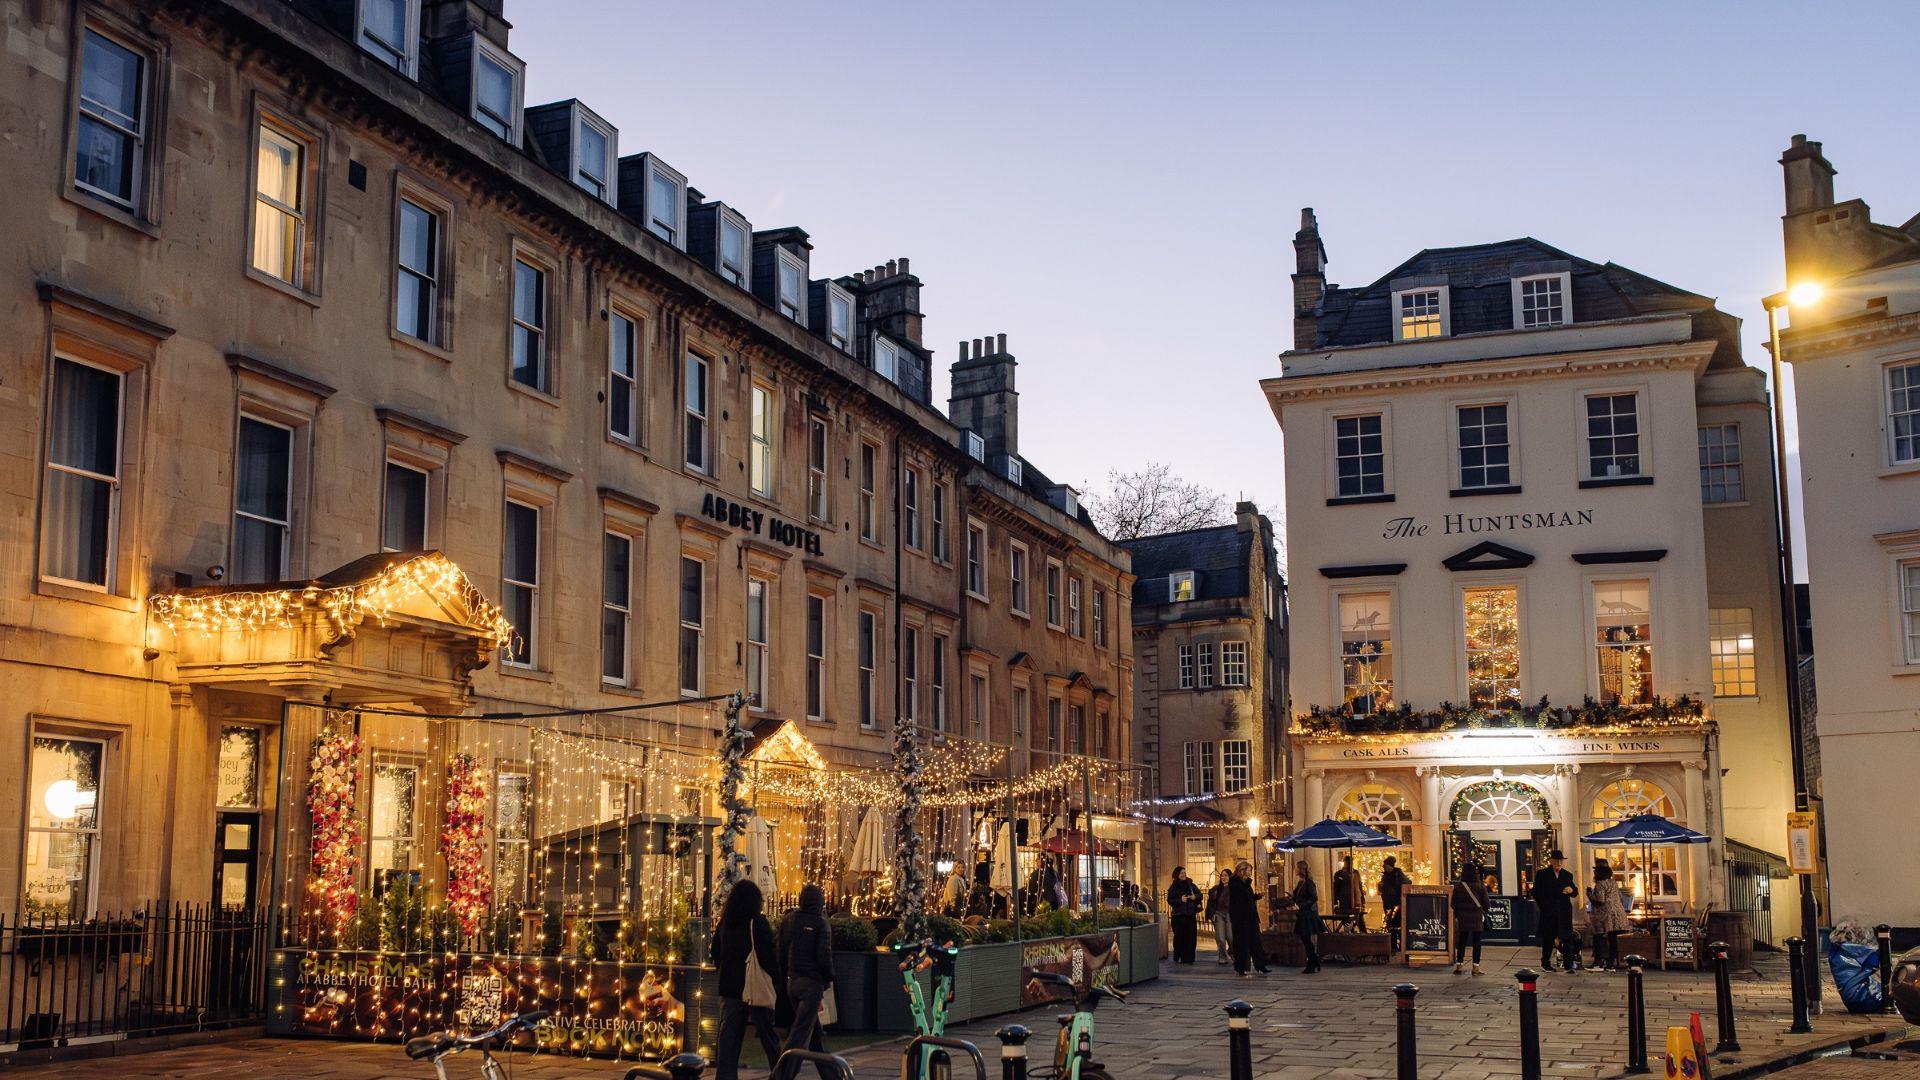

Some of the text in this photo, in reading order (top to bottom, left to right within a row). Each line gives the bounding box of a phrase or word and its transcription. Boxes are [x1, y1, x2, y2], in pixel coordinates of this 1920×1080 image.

[701, 493, 824, 556] ABBEY HOTEL
[1383, 509, 1593, 539] The HUNTSMAN
[1343, 747, 1409, 757] CASK ALES
[1583, 742, 1660, 751] FINE WINES
[1023, 944, 1066, 959] CHRISTMAS
[298, 958, 436, 979] CHRISTMAS
[297, 974, 437, 989] AT ABBEY HOTEL BATH
[538, 1016, 675, 1034] STIVE CELEBRATIONS
[534, 1027, 675, 1050] BOOK NOW
